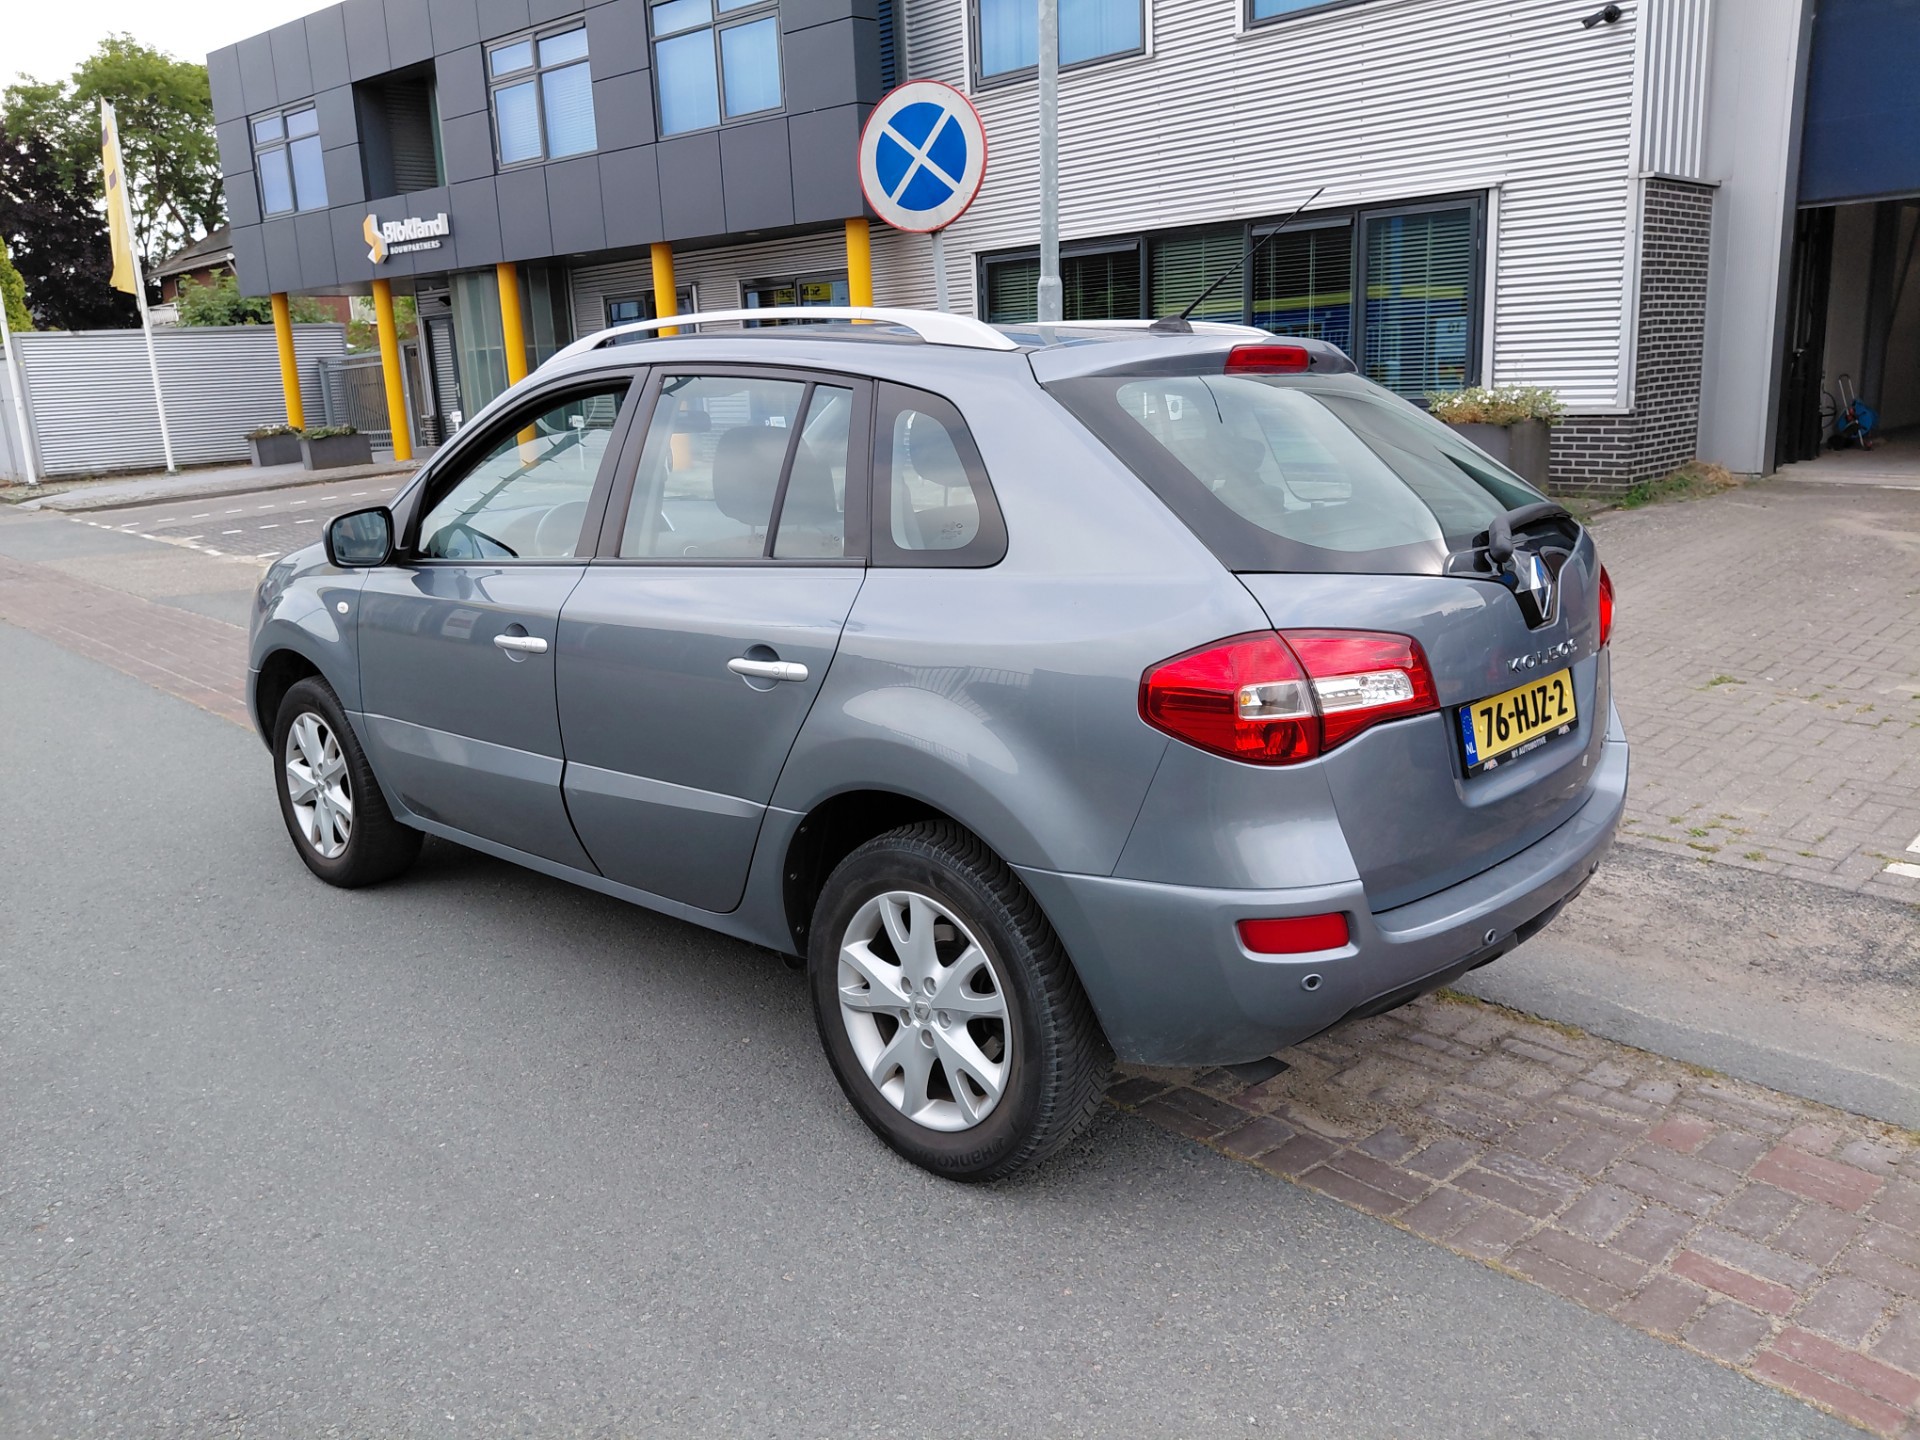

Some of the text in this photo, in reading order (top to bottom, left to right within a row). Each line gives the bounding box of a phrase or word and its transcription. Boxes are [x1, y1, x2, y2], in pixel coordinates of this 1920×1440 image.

[382, 212, 450, 244] Blokland
[389, 240, 442, 255] BOUWPARTNERS
[1507, 638, 1578, 674] KOLEOS
[1479, 679, 1569, 749] 76-HJZ-2
[1465, 743, 1477, 755] NL
